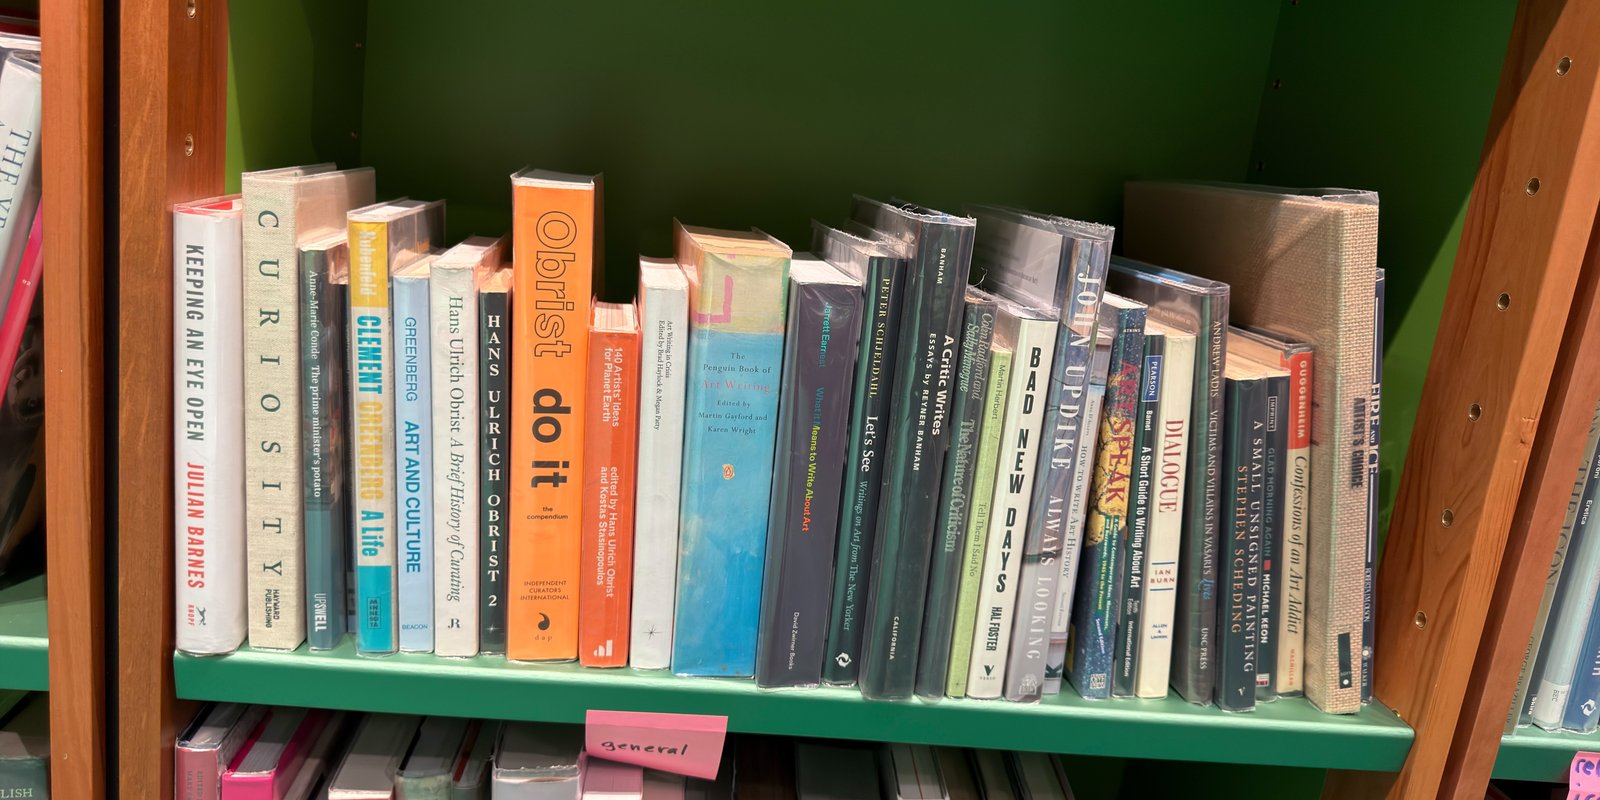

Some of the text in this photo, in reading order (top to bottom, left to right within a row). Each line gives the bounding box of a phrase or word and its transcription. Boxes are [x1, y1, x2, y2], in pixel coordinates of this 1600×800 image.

[0, 129, 32, 186] THE
[936, 248, 946, 284] BANHAM
[186, 244, 204, 442] KEEPING AN EYE OPEN
[531, 210, 577, 488] Obrist do it
[703, 364, 772, 374] Penguin Book of
[819, 302, 832, 368] Jarrett Earnest
[869, 278, 890, 398] PETER SCHJELDAHL
[1051, 272, 1101, 469] JOHN UPDIKE
[1210, 321, 1221, 397] ANDREW LADIS
[258, 209, 282, 576] CURIOSITY
[309, 271, 322, 497] Anne-Marie Conde The prime minister's potato
[602, 347, 613, 422] for Planet Earth
[612, 347, 623, 427] 140 Artists' Ideas
[702, 380, 770, 393] Art Writing
[816, 388, 824, 410] What
[913, 333, 936, 471] ESSAYS by REYNER BANHAM
[932, 335, 954, 436] A Critic Writes
[1149, 362, 1158, 396] PEARSON
[1268, 398, 1276, 429] IMPRINT
[1298, 360, 1307, 439] GUGGENHEIM
[357, 316, 384, 556] CLEMENT GREENBERG A Life
[404, 317, 420, 573] GREENBERG ART AND CULTURE
[447, 296, 464, 602] Hans Ulrich Obrist A Brief History of Curating
[725, 413, 753, 422] Gayford
[731, 426, 756, 434] Wright
[810, 419, 821, 451] Means
[861, 415, 878, 472] Let's See
[1105, 360, 1138, 504] ARTSPEAK
[1145, 410, 1153, 431] Barnet
[1351, 398, 1365, 489] ARTIST'S CHOICE
[488, 315, 500, 606] HANS ULRICH OBRIST 2
[806, 463, 816, 487] Write
[809, 452, 817, 462] to
[944, 419, 975, 552] The Nature of Criticism
[996, 347, 1042, 592] BAD NEW DAYS
[1138, 480, 1148, 505] Guide
[1141, 456, 1151, 478] Short
[1159, 420, 1184, 512] DIALOGUE
[187, 462, 205, 588] JULIAN BARNES
[596, 466, 608, 586] and Kostas Stasinopoulos
[606, 466, 618, 598] edited by Hans Ulrich Obrist
[804, 488, 813, 516] About
[1132, 517, 1145, 547] Writing
[1136, 507, 1145, 515] to
[1200, 410, 1218, 600] VICTIMS AND VILLAINS IN VASARI'S Lives
[1264, 448, 1276, 556] GLAD MORNING AGAIN
[1581, 500, 1593, 525] Eretica
[843, 481, 868, 631] Writings on Art from The New Yorker
[1026, 496, 1064, 659] ALWAYS LOOKING
[1130, 575, 1141, 588] Art
[1132, 549, 1144, 573] About
[1231, 466, 1247, 633] STEPHEN SCHEDING
[1244, 421, 1264, 673] A SMALL UNSIGNED PAINTING
[1288, 456, 1307, 634] Confessions of an Art Addict
[314, 594, 327, 632] UPSWELL
[889, 616, 899, 660] CALIFORNIA
[986, 607, 1002, 651] HAL FOSTER
[1260, 574, 1271, 643] MICHAEL KEON
[1528, 697, 1537, 715] Skira
[602, 741, 688, 755] general
